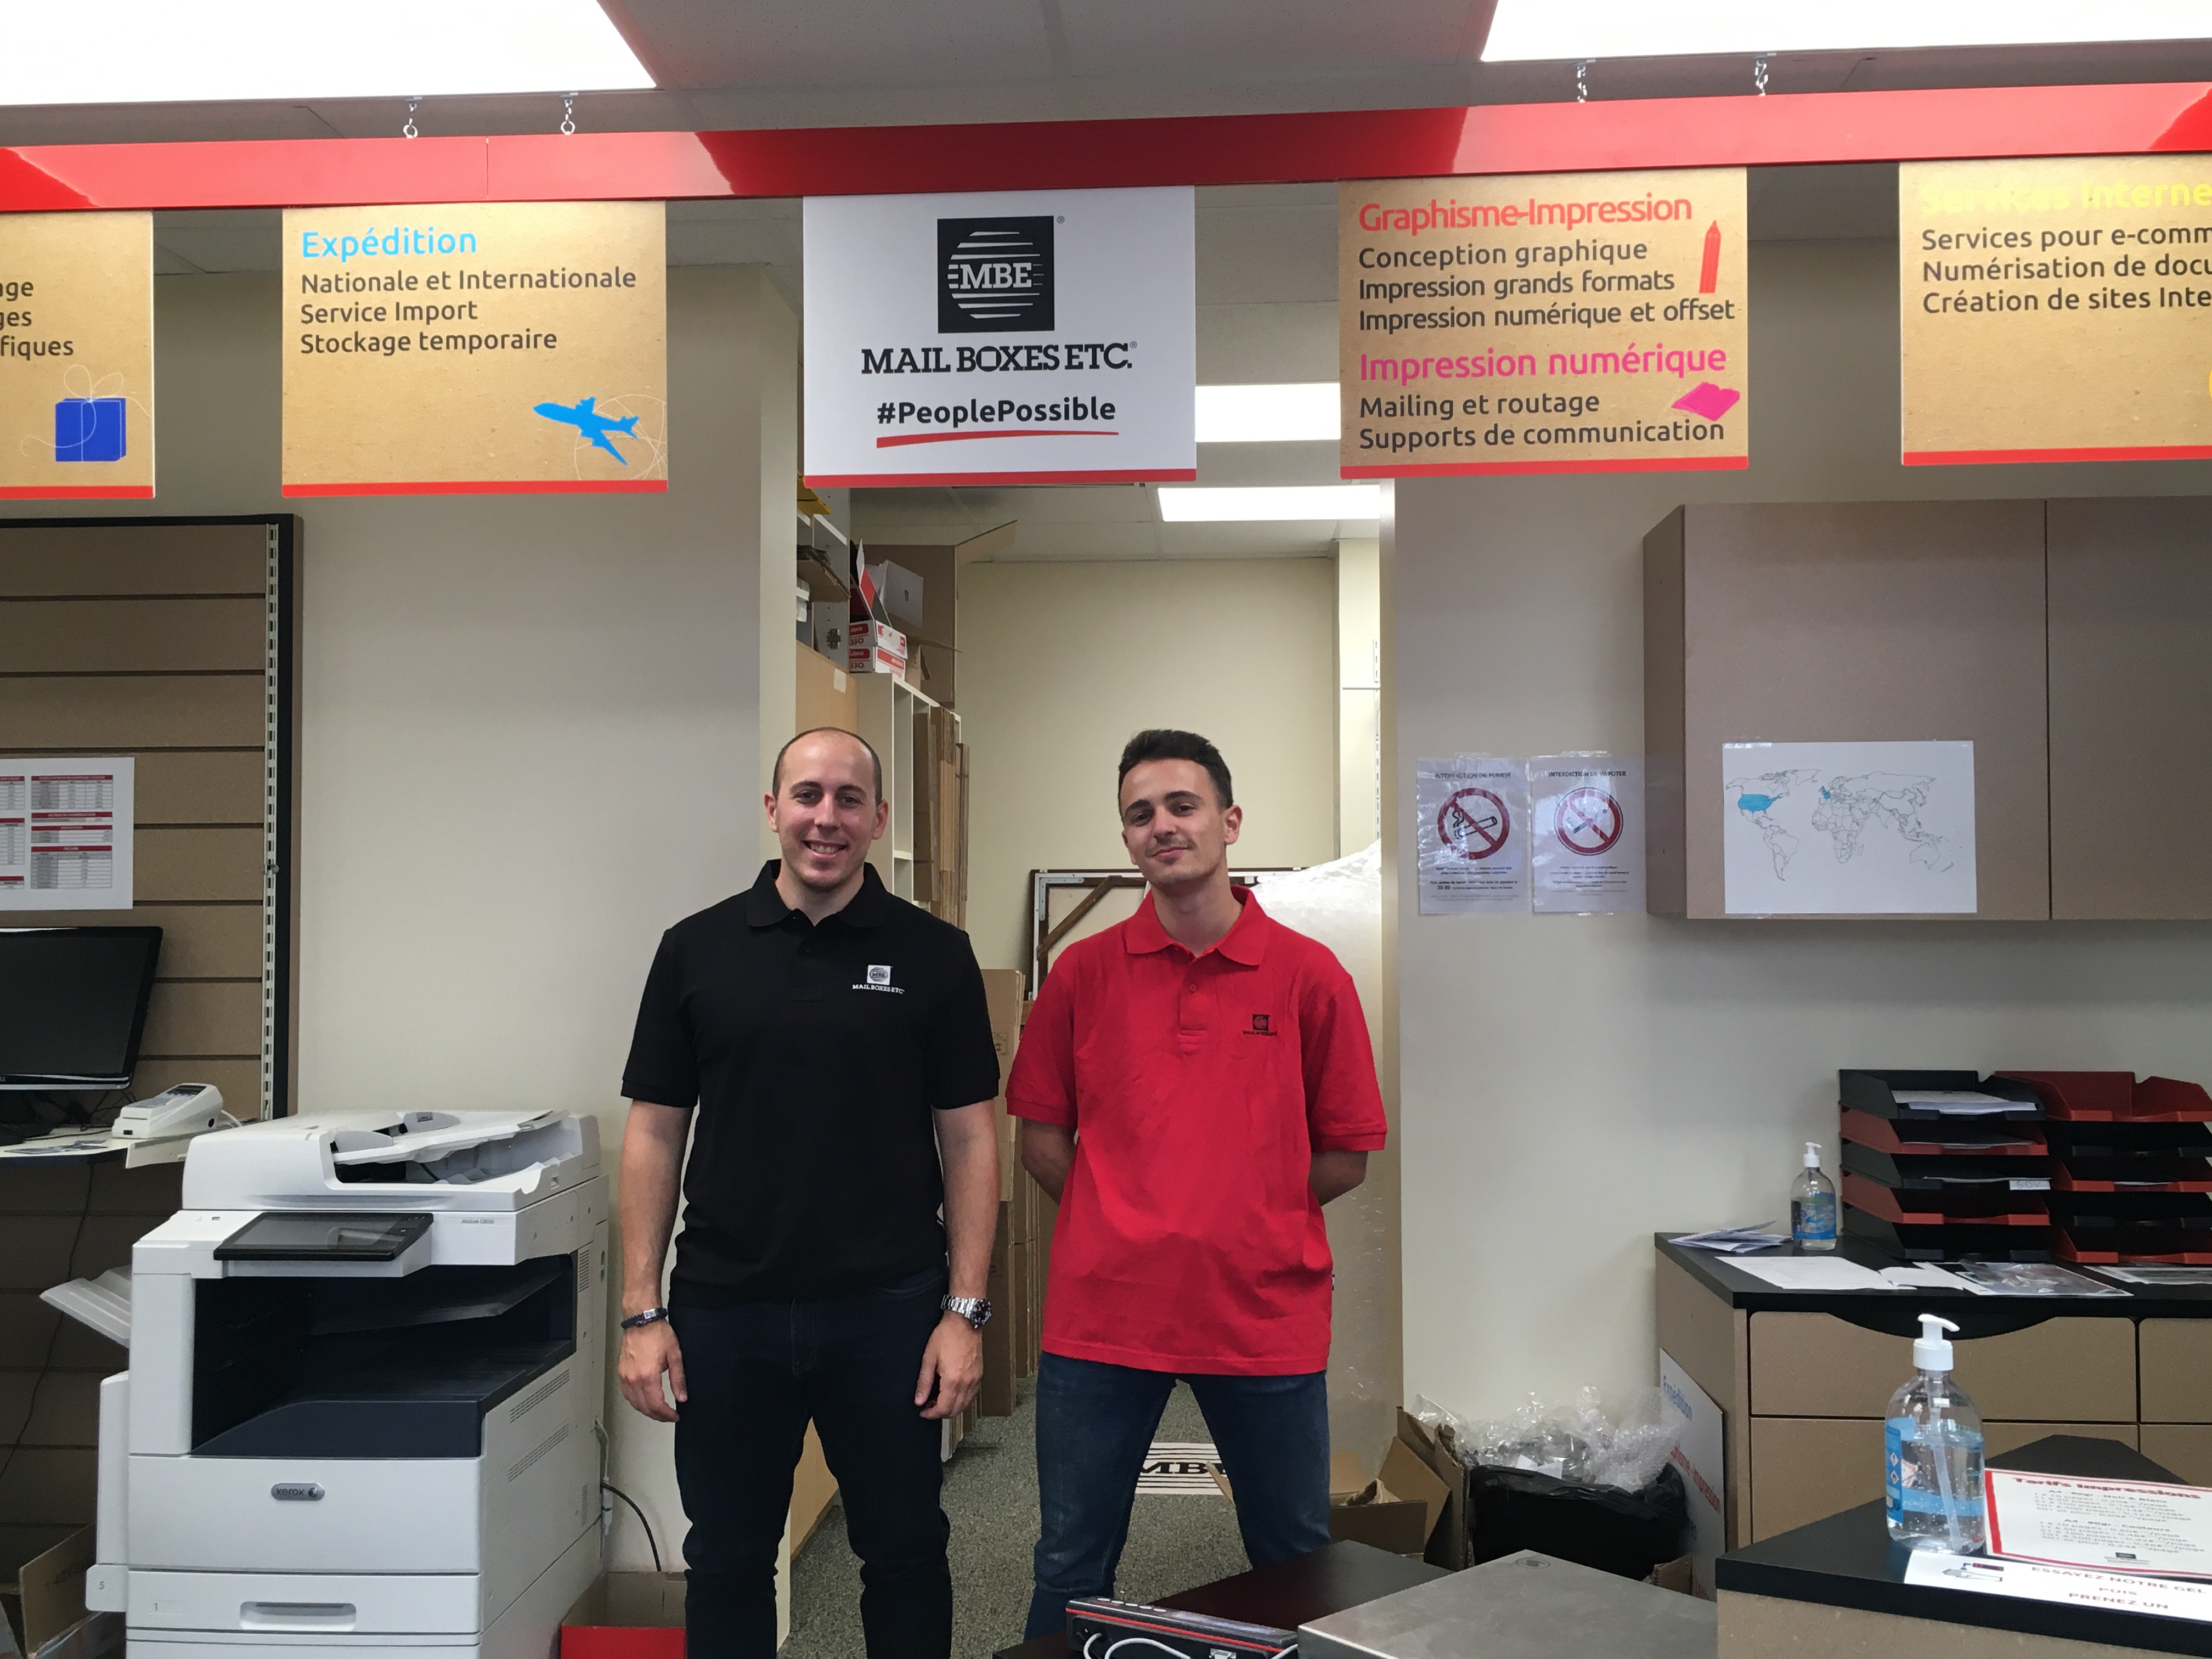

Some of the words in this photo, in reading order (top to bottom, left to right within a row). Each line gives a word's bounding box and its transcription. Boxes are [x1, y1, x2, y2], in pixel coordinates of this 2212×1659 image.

[1358, 192, 1692, 235] Graphisme-Impression
[1921, 184, 2071, 215] Services
[302, 226, 477, 263] Expédition
[1922, 227, 2032, 250] Services
[2041, 228, 2103, 251] pour
[1359, 244, 1506, 270] Conception
[1515, 239, 1647, 266] graphique
[1923, 256, 2105, 281] Numérisation
[2114, 255, 2146, 277] de
[301, 270, 418, 294] Nationale
[426, 272, 451, 290] et
[460, 266, 636, 290] Internationale
[960, 262, 1032, 289] MBE
[1359, 275, 1485, 303] Impression
[1494, 272, 1573, 300] grands
[1583, 269, 1675, 292] formats
[0, 281, 33, 301] ge
[1923, 288, 2038, 313] Création
[2048, 288, 2079, 311] de
[2089, 287, 2151, 309] sites
[301, 302, 386, 325] Service
[395, 300, 478, 325] Import
[1359, 306, 1485, 335] Impression
[1495, 303, 1621, 328] numérique
[1630, 301, 1655, 322] et
[1663, 297, 1735, 321] offset
[301, 331, 410, 357] Stockage
[419, 328, 557, 354] temporaire
[861, 347, 951, 374] MAIL
[957, 345, 1059, 373] BOXES
[1360, 348, 1536, 386] Impression
[1549, 342, 1726, 379] numérique
[878, 397, 1115, 427] #PeoplePossible
[1359, 394, 1454, 421] Mailing
[1463, 394, 1488, 415] et
[1497, 393, 1600, 417] routage
[1359, 427, 1475, 453] Supports
[1484, 424, 1515, 445] de
[1523, 419, 1724, 444] communication
[2013, 1477, 2072, 1487] Tarifs
[2076, 1483, 2202, 1499] Impressions
[99, 1581, 105, 1589] 5
[2032, 1567, 2105, 1580] ESSAYEZ
[2109, 1577, 2169, 1589] NOTRE
[2098, 1587, 2138, 1595] PUIS
[2068, 1593, 2138, 1605] PRENEZ
